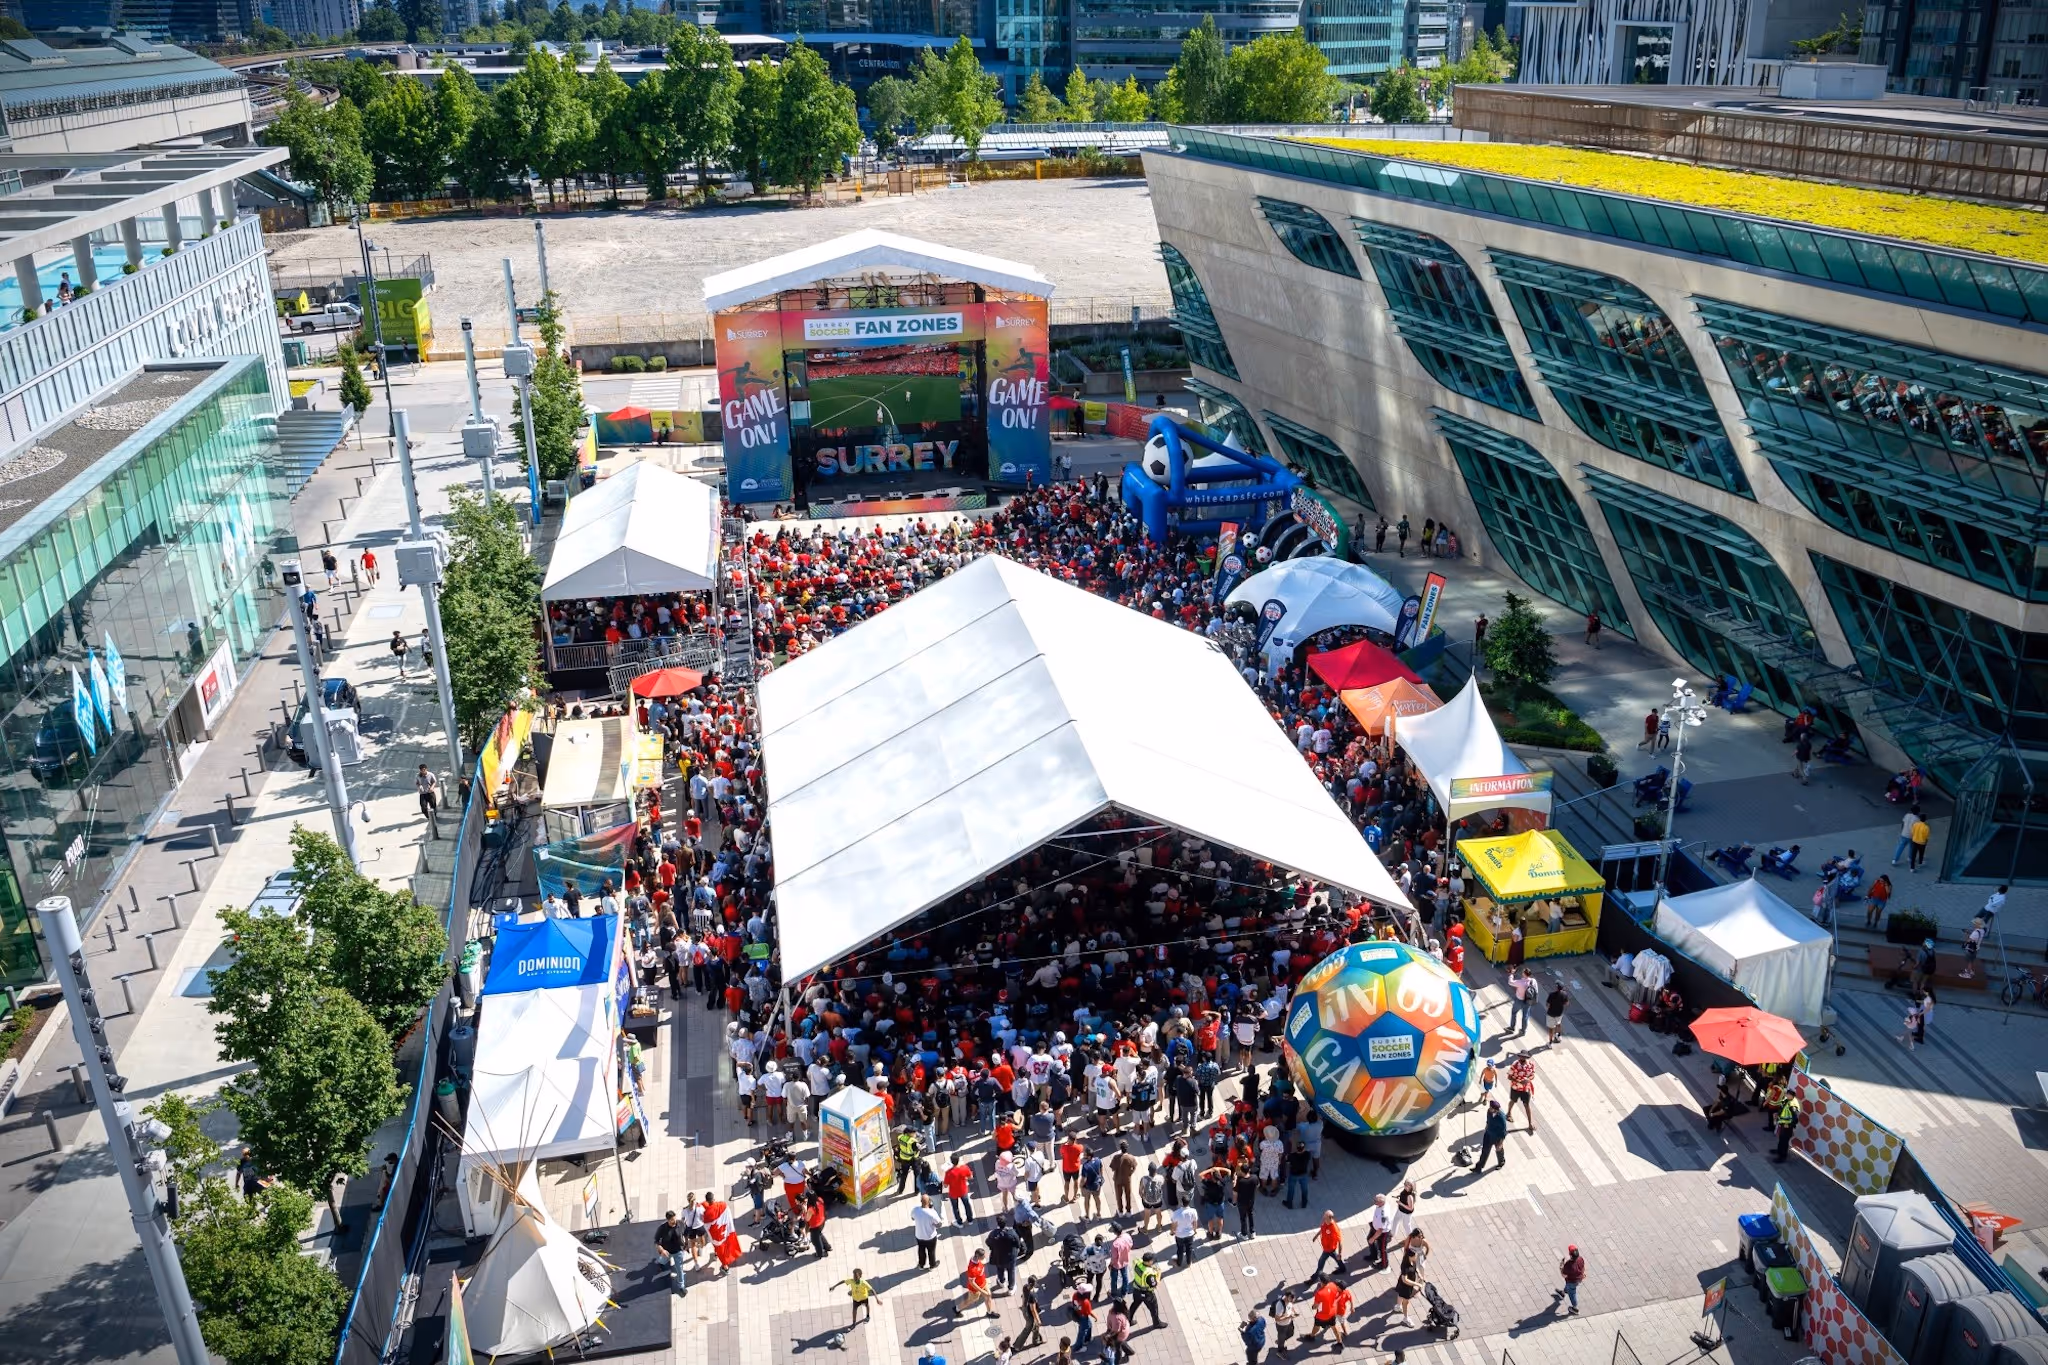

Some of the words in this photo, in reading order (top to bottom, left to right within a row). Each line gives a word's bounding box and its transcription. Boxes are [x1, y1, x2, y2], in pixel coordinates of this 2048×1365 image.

[855, 320, 892, 335] FAN
[897, 317, 958, 333] ZONES
[1005, 318, 1035, 327] SURREY
[737, 329, 769, 339] SURREY
[809, 328, 850, 337] SOCCER
[989, 377, 1048, 406] GAME
[725, 386, 785, 429] GAME
[1001, 407, 1038, 429] ON!
[740, 421, 778, 448] ON!
[815, 440, 960, 476] SURREY
[1185, 490, 1285, 504] whitecapsfc.com
[1425, 586, 1438, 614] ZONES
[1420, 614, 1431, 630] FAN
[1469, 778, 1534, 794] INFORMATION
[1528, 868, 1566, 879] Donuts
[518, 956, 581, 976] DOMINION
[1371, 1043, 1411, 1053] SOCCER
[1388, 1051, 1412, 1059] ZONES
[1033, 1062, 1049, 1075] 67
